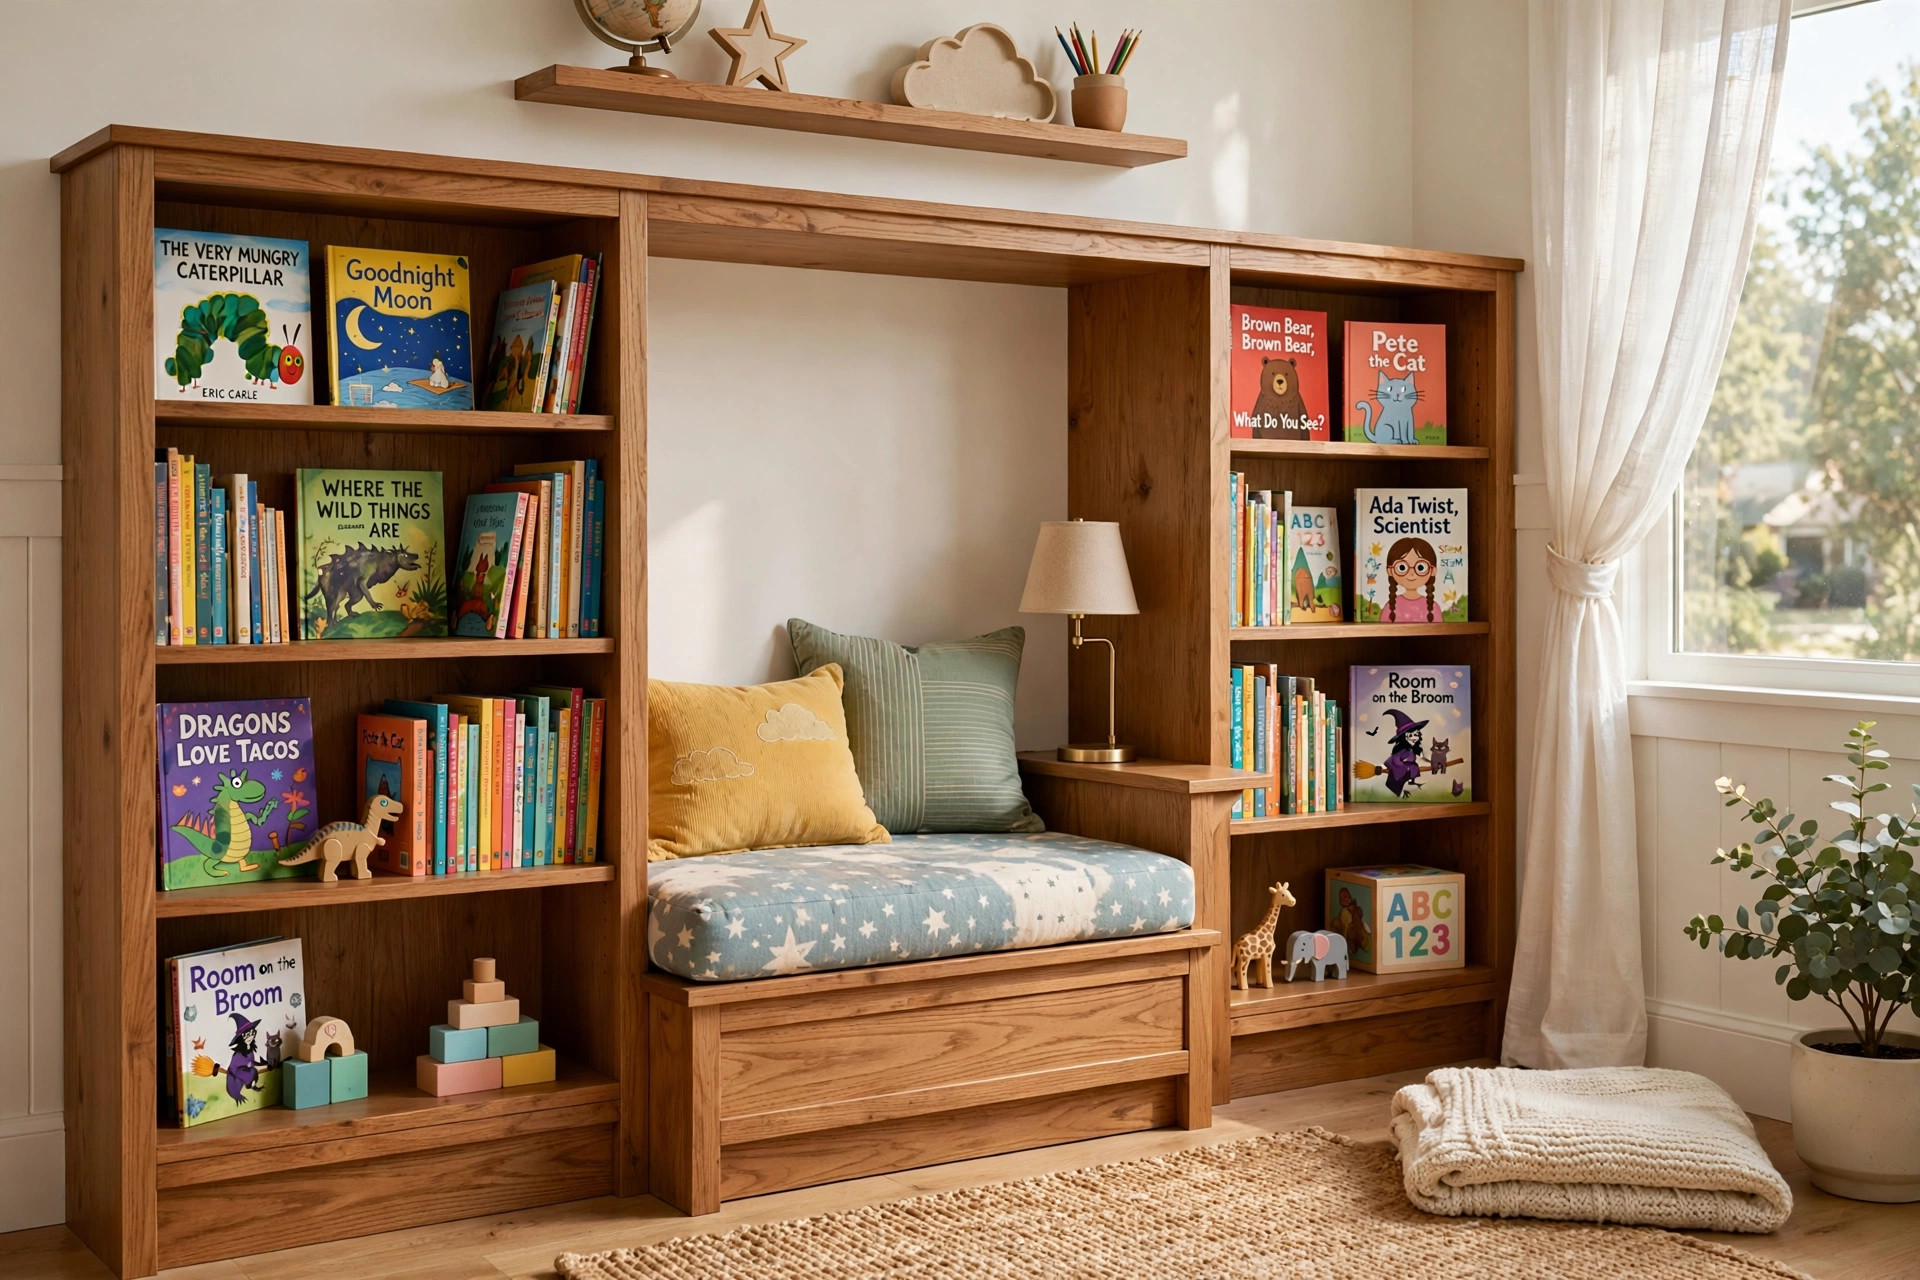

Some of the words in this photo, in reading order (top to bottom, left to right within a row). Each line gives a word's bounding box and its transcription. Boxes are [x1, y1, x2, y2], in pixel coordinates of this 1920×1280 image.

[160, 240, 189, 257] THE
[195, 242, 233, 261] VERY
[238, 247, 300, 267] MUNGRY
[177, 261, 284, 287] CATERPILLAR
[346, 258, 455, 293] Goodnight
[374, 285, 432, 310] Moon
[1241, 313, 1281, 333] Brown
[1284, 317, 1315, 338] Bear,
[1241, 333, 1281, 351] Brown
[1284, 336, 1315, 357] Bear,
[1371, 330, 1419, 353] Pete
[1368, 354, 1390, 368] the
[1393, 353, 1426, 372] Cat
[202, 388, 225, 399] ERIC
[228, 389, 258, 400] CARLE
[1233, 411, 1261, 429] What
[1264, 413, 1278, 428] Do
[1280, 413, 1299, 430] You
[1300, 414, 1325, 431] See?
[322, 479, 384, 497] WHERE
[391, 481, 423, 497] THE
[317, 501, 362, 519] WILD
[368, 502, 430, 519] THINGS
[1369, 496, 1403, 514] Ada
[1407, 496, 1459, 516] Twist,
[369, 523, 400, 538] ARE
[1291, 513, 1325, 529] ABC
[1373, 516, 1451, 534] Scientist
[1297, 531, 1326, 547] 123
[1388, 672, 1436, 689] Room
[1372, 694, 1386, 703] on
[1389, 691, 1408, 703] the
[1411, 689, 1454, 704] Broom
[179, 711, 291, 740] DRAGONS
[176, 742, 231, 767] LOVE
[236, 739, 300, 763] TACOS
[1386, 889, 1452, 923] ABC
[1389, 923, 1451, 959] 123
[189, 963, 255, 994] Room
[259, 963, 273, 975] on
[277, 956, 296, 971] the
[215, 985, 283, 1016] Broom
